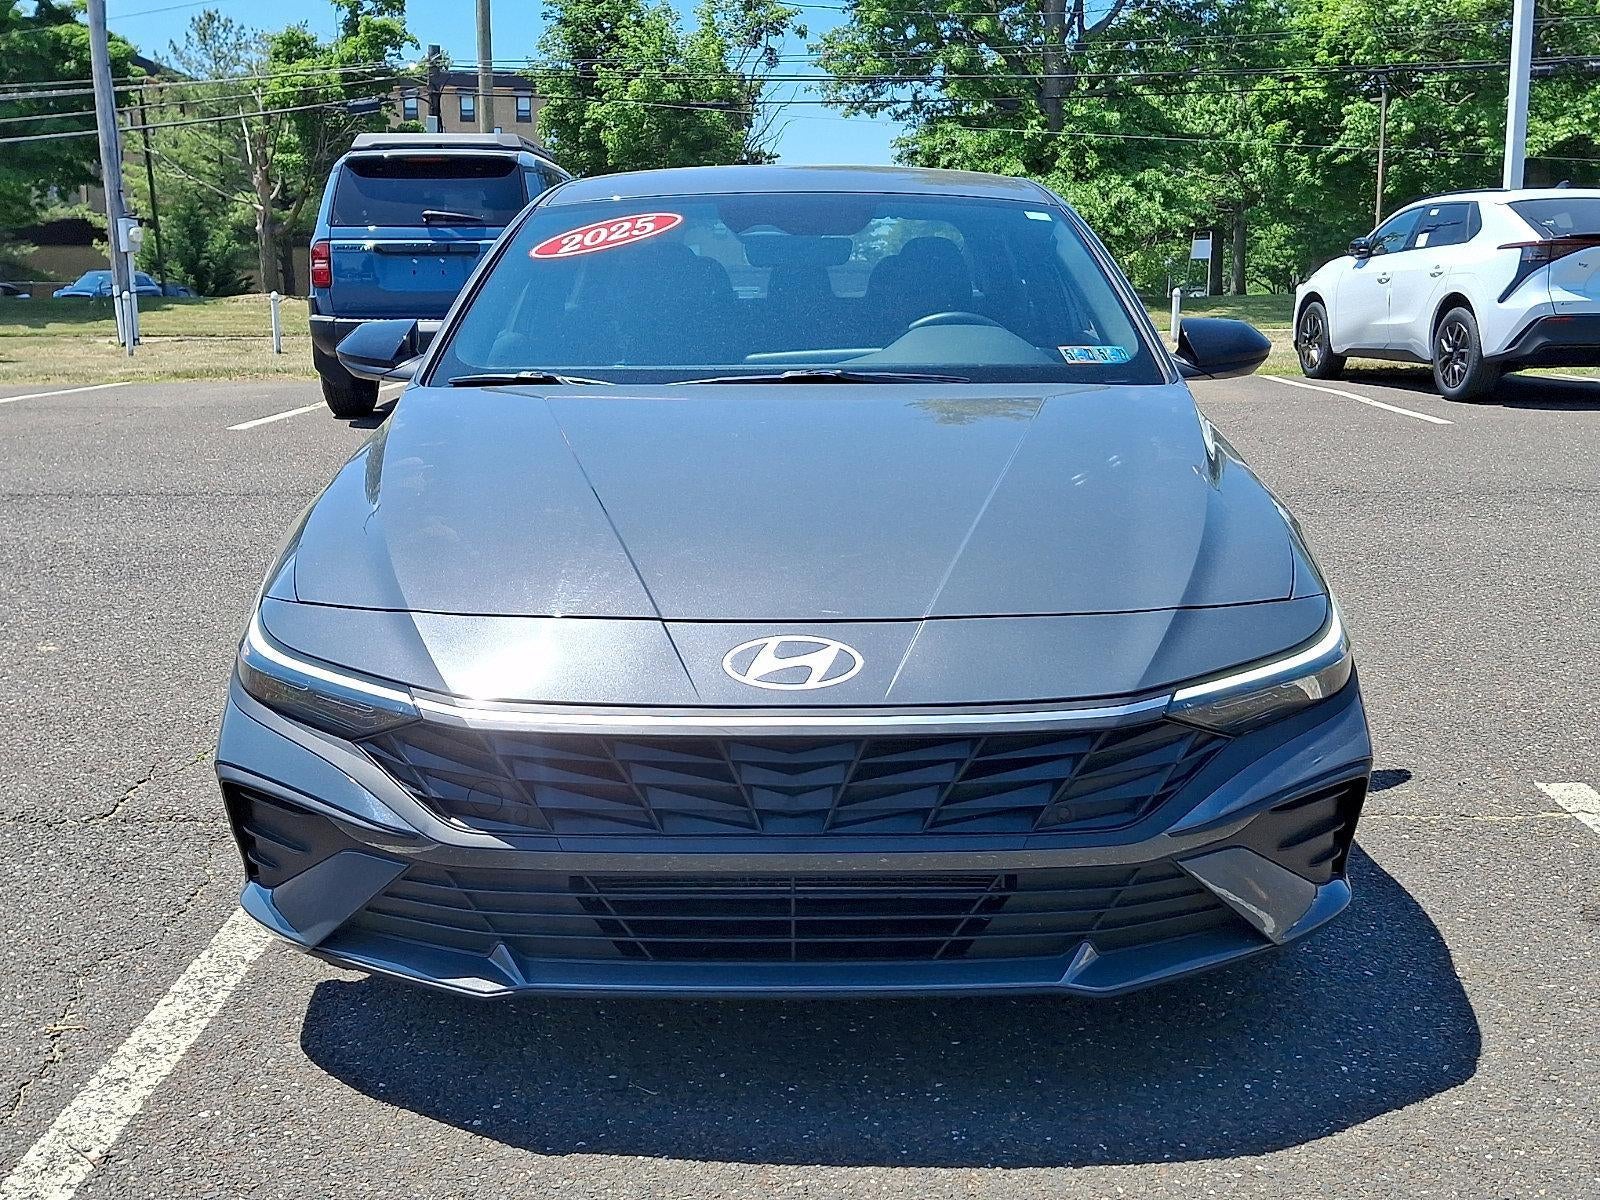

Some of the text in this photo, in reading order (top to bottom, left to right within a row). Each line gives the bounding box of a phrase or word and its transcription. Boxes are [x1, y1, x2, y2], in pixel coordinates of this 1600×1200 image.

[556, 216, 657, 254] 2025
[1064, 349, 1075, 360] 5
[1097, 349, 1108, 360] 5
